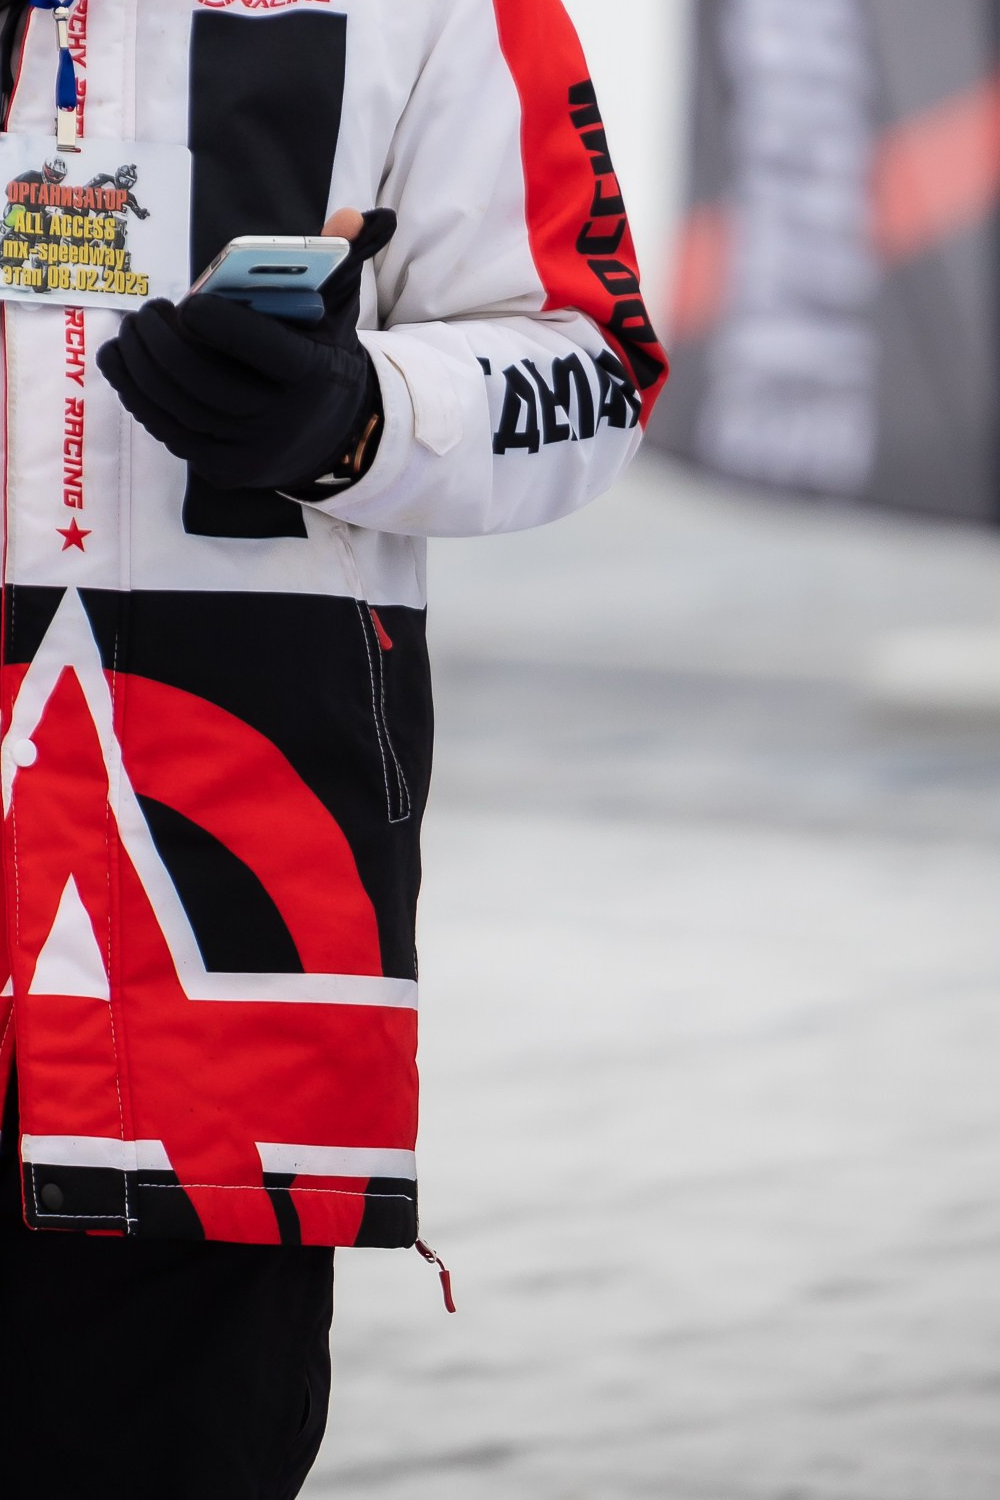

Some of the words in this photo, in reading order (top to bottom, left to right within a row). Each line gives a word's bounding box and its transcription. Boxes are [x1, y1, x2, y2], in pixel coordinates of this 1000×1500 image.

[7, 180, 128, 212] ОРГАНИЗАТОР
[14, 211, 44, 235] ALL
[49, 214, 117, 241] ACCESS
[3, 240, 126, 271] mx-speedway
[3, 266, 42, 287] этап
[48, 267, 149, 296] 08.02.2025
[63, 396, 86, 510] RACING
